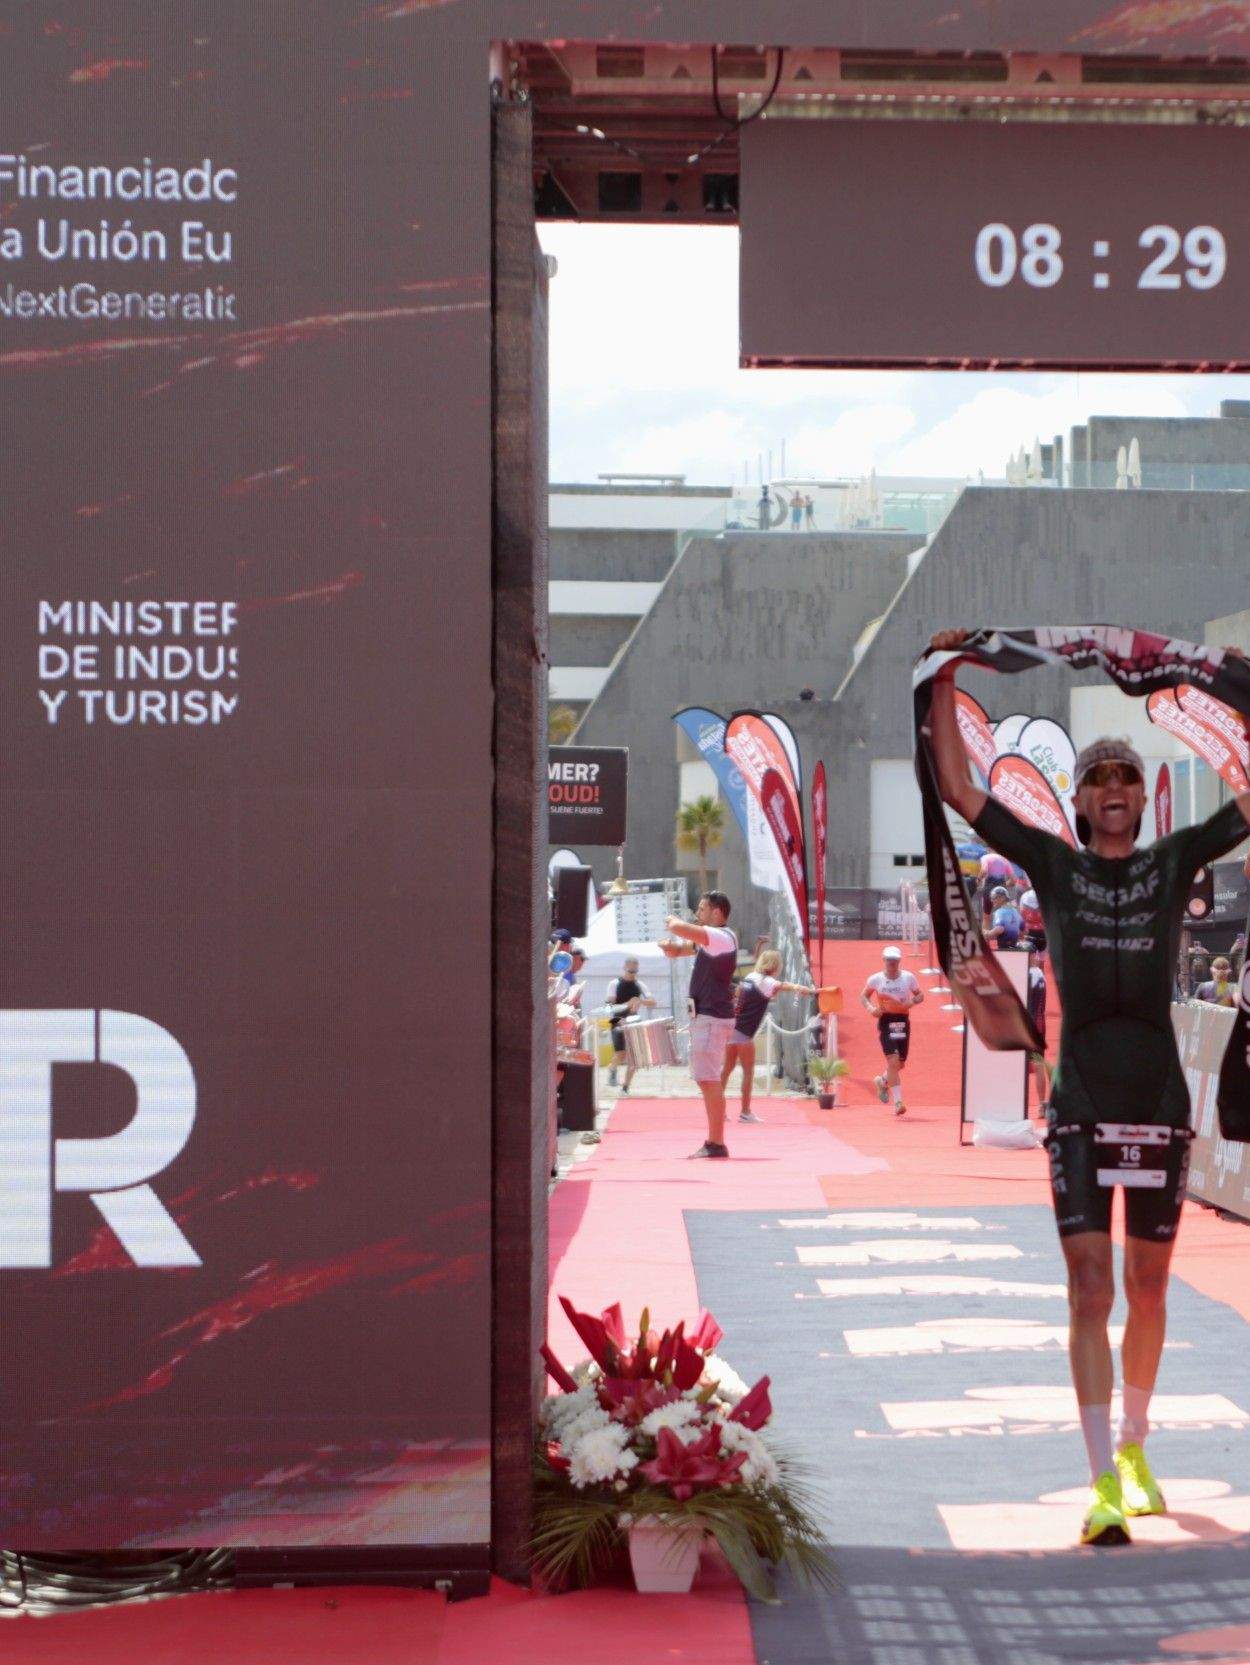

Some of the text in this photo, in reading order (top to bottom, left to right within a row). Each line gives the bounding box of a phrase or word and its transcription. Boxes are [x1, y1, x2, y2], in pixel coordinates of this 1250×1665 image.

[38, 218, 166, 261] Unión
[181, 220, 232, 262] Eu
[975, 223, 1063, 288] 08
[1137, 225, 1227, 290] 29
[38, 644, 99, 681] DE
[38, 689, 68, 725] Y
[1120, 1145, 1142, 1162] 16
